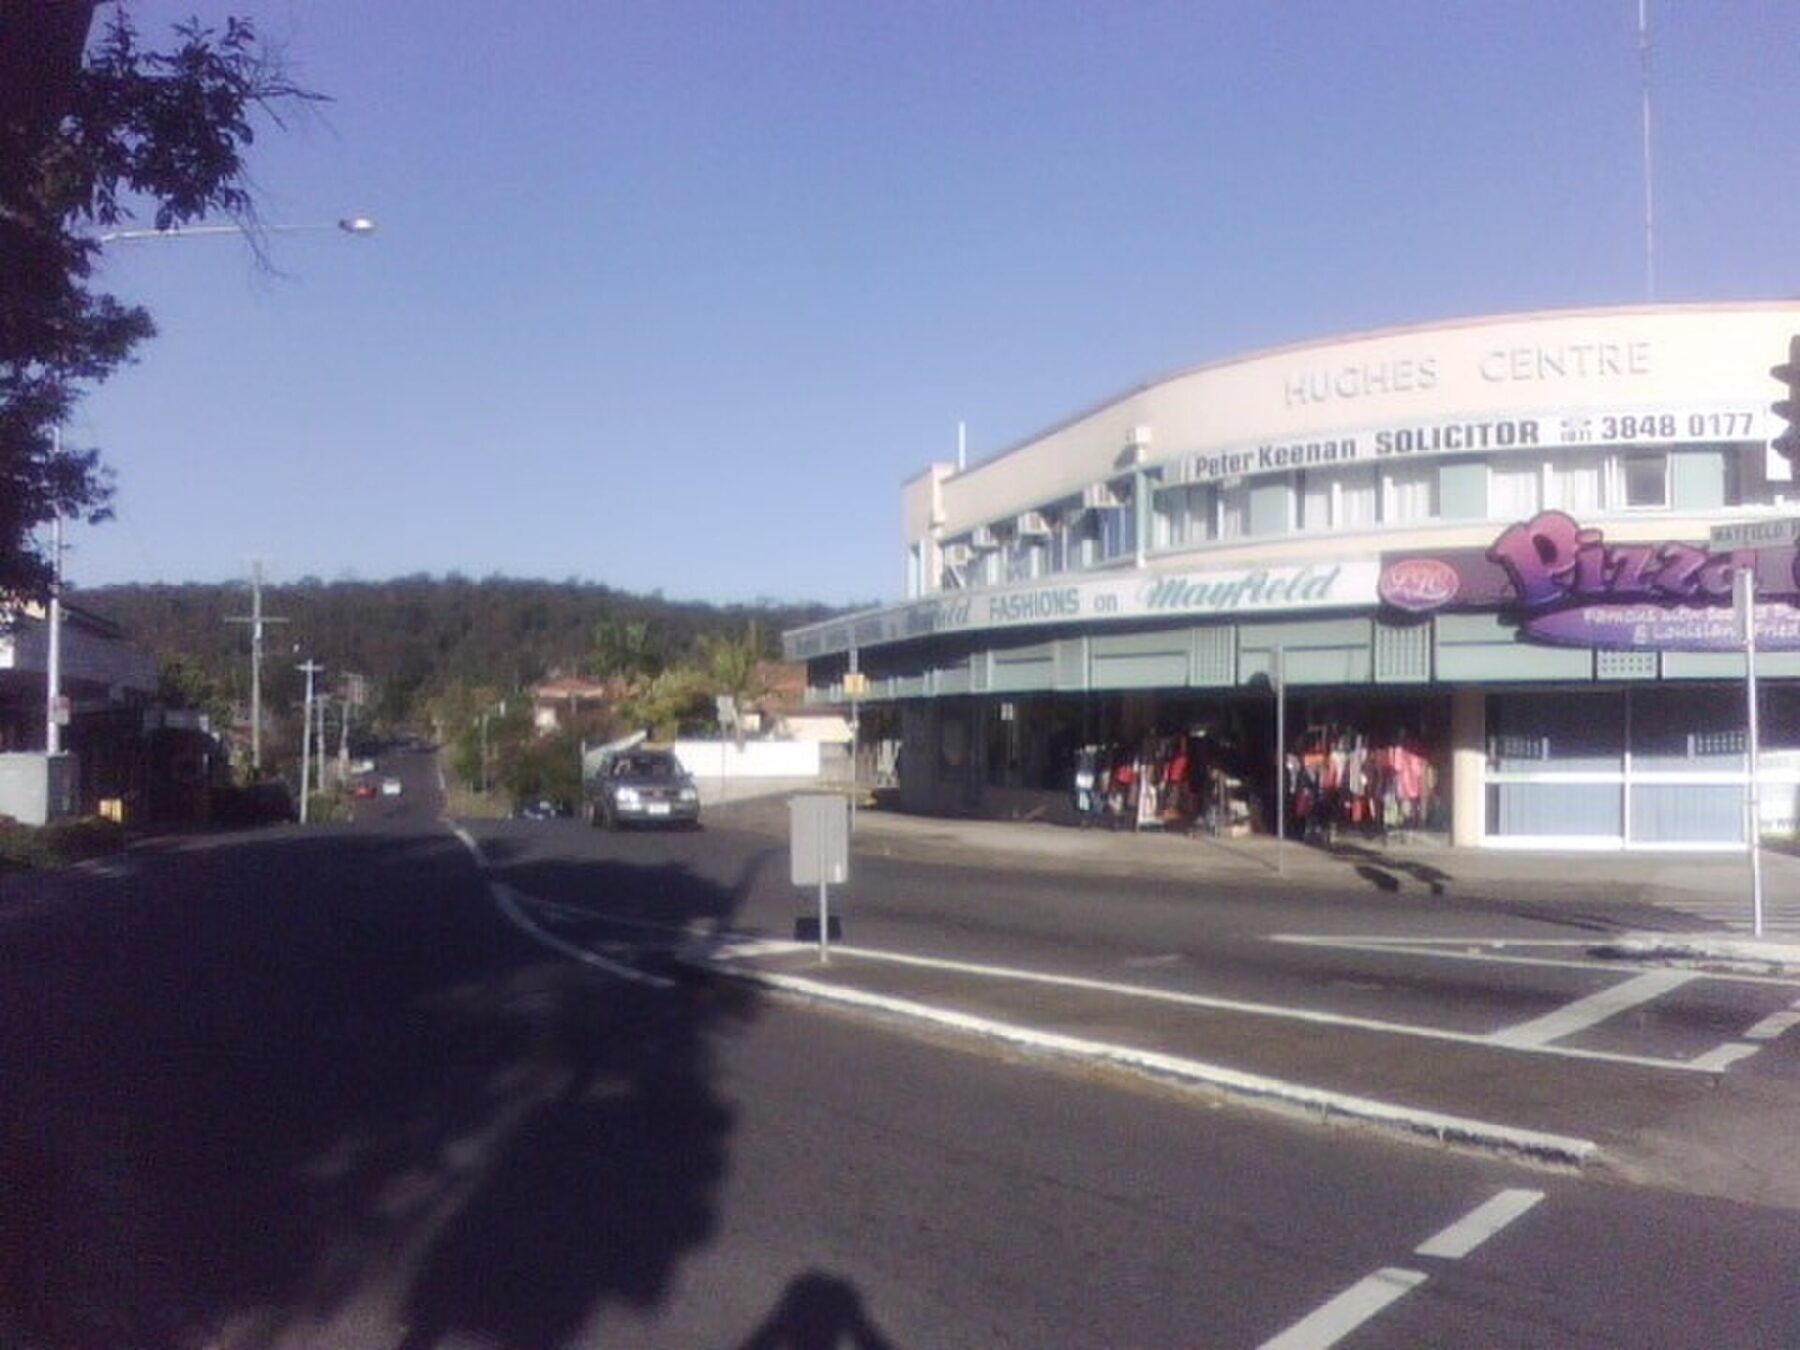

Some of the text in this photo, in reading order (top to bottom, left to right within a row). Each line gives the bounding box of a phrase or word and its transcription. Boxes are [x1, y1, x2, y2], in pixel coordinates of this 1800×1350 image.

[1285, 341, 1652, 408] HUGHES CENTRE
[1195, 452, 1254, 478] Peter
[1258, 438, 1356, 469] Keenan
[1374, 419, 1540, 456] SOLICITOR
[1600, 414, 1677, 441] 3848
[1688, 411, 1754, 437] 0177
[1714, 521, 1786, 542] MAYFIELD
[989, 588, 1079, 622] FASHIONS
[1094, 594, 1118, 612] on
[1138, 564, 1342, 613] Mayfield
